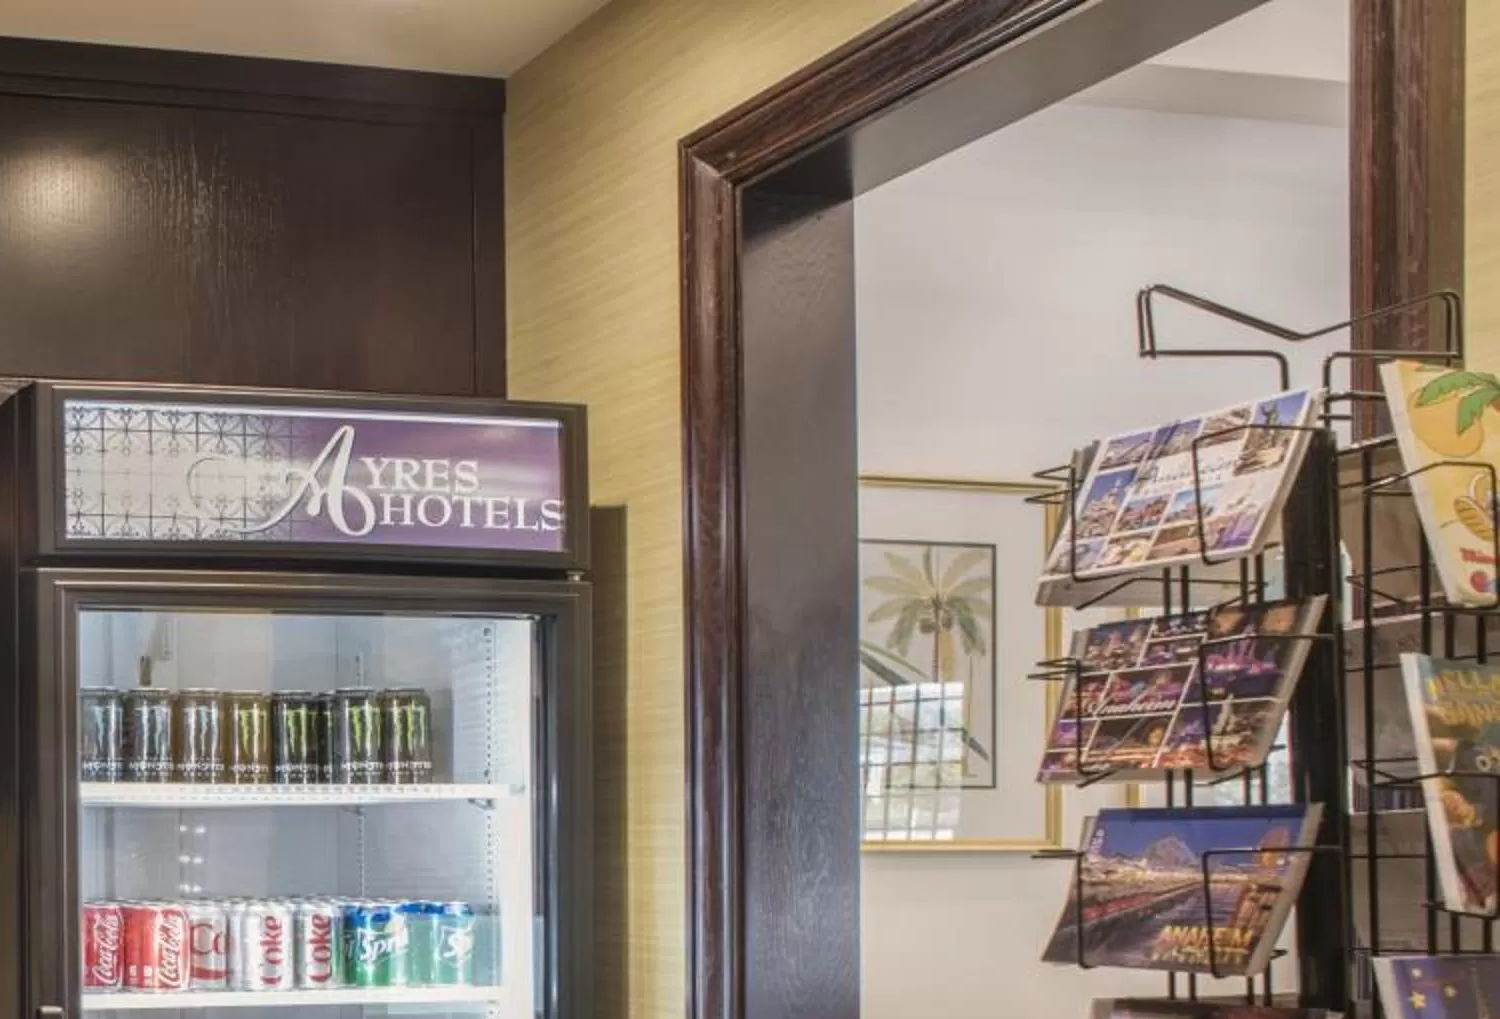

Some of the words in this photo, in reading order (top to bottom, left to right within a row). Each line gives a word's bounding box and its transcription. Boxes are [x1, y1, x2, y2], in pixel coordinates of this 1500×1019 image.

[238, 425, 479, 537] AYRES
[379, 494, 566, 532] HOTELS
[307, 912, 333, 984] Coke
